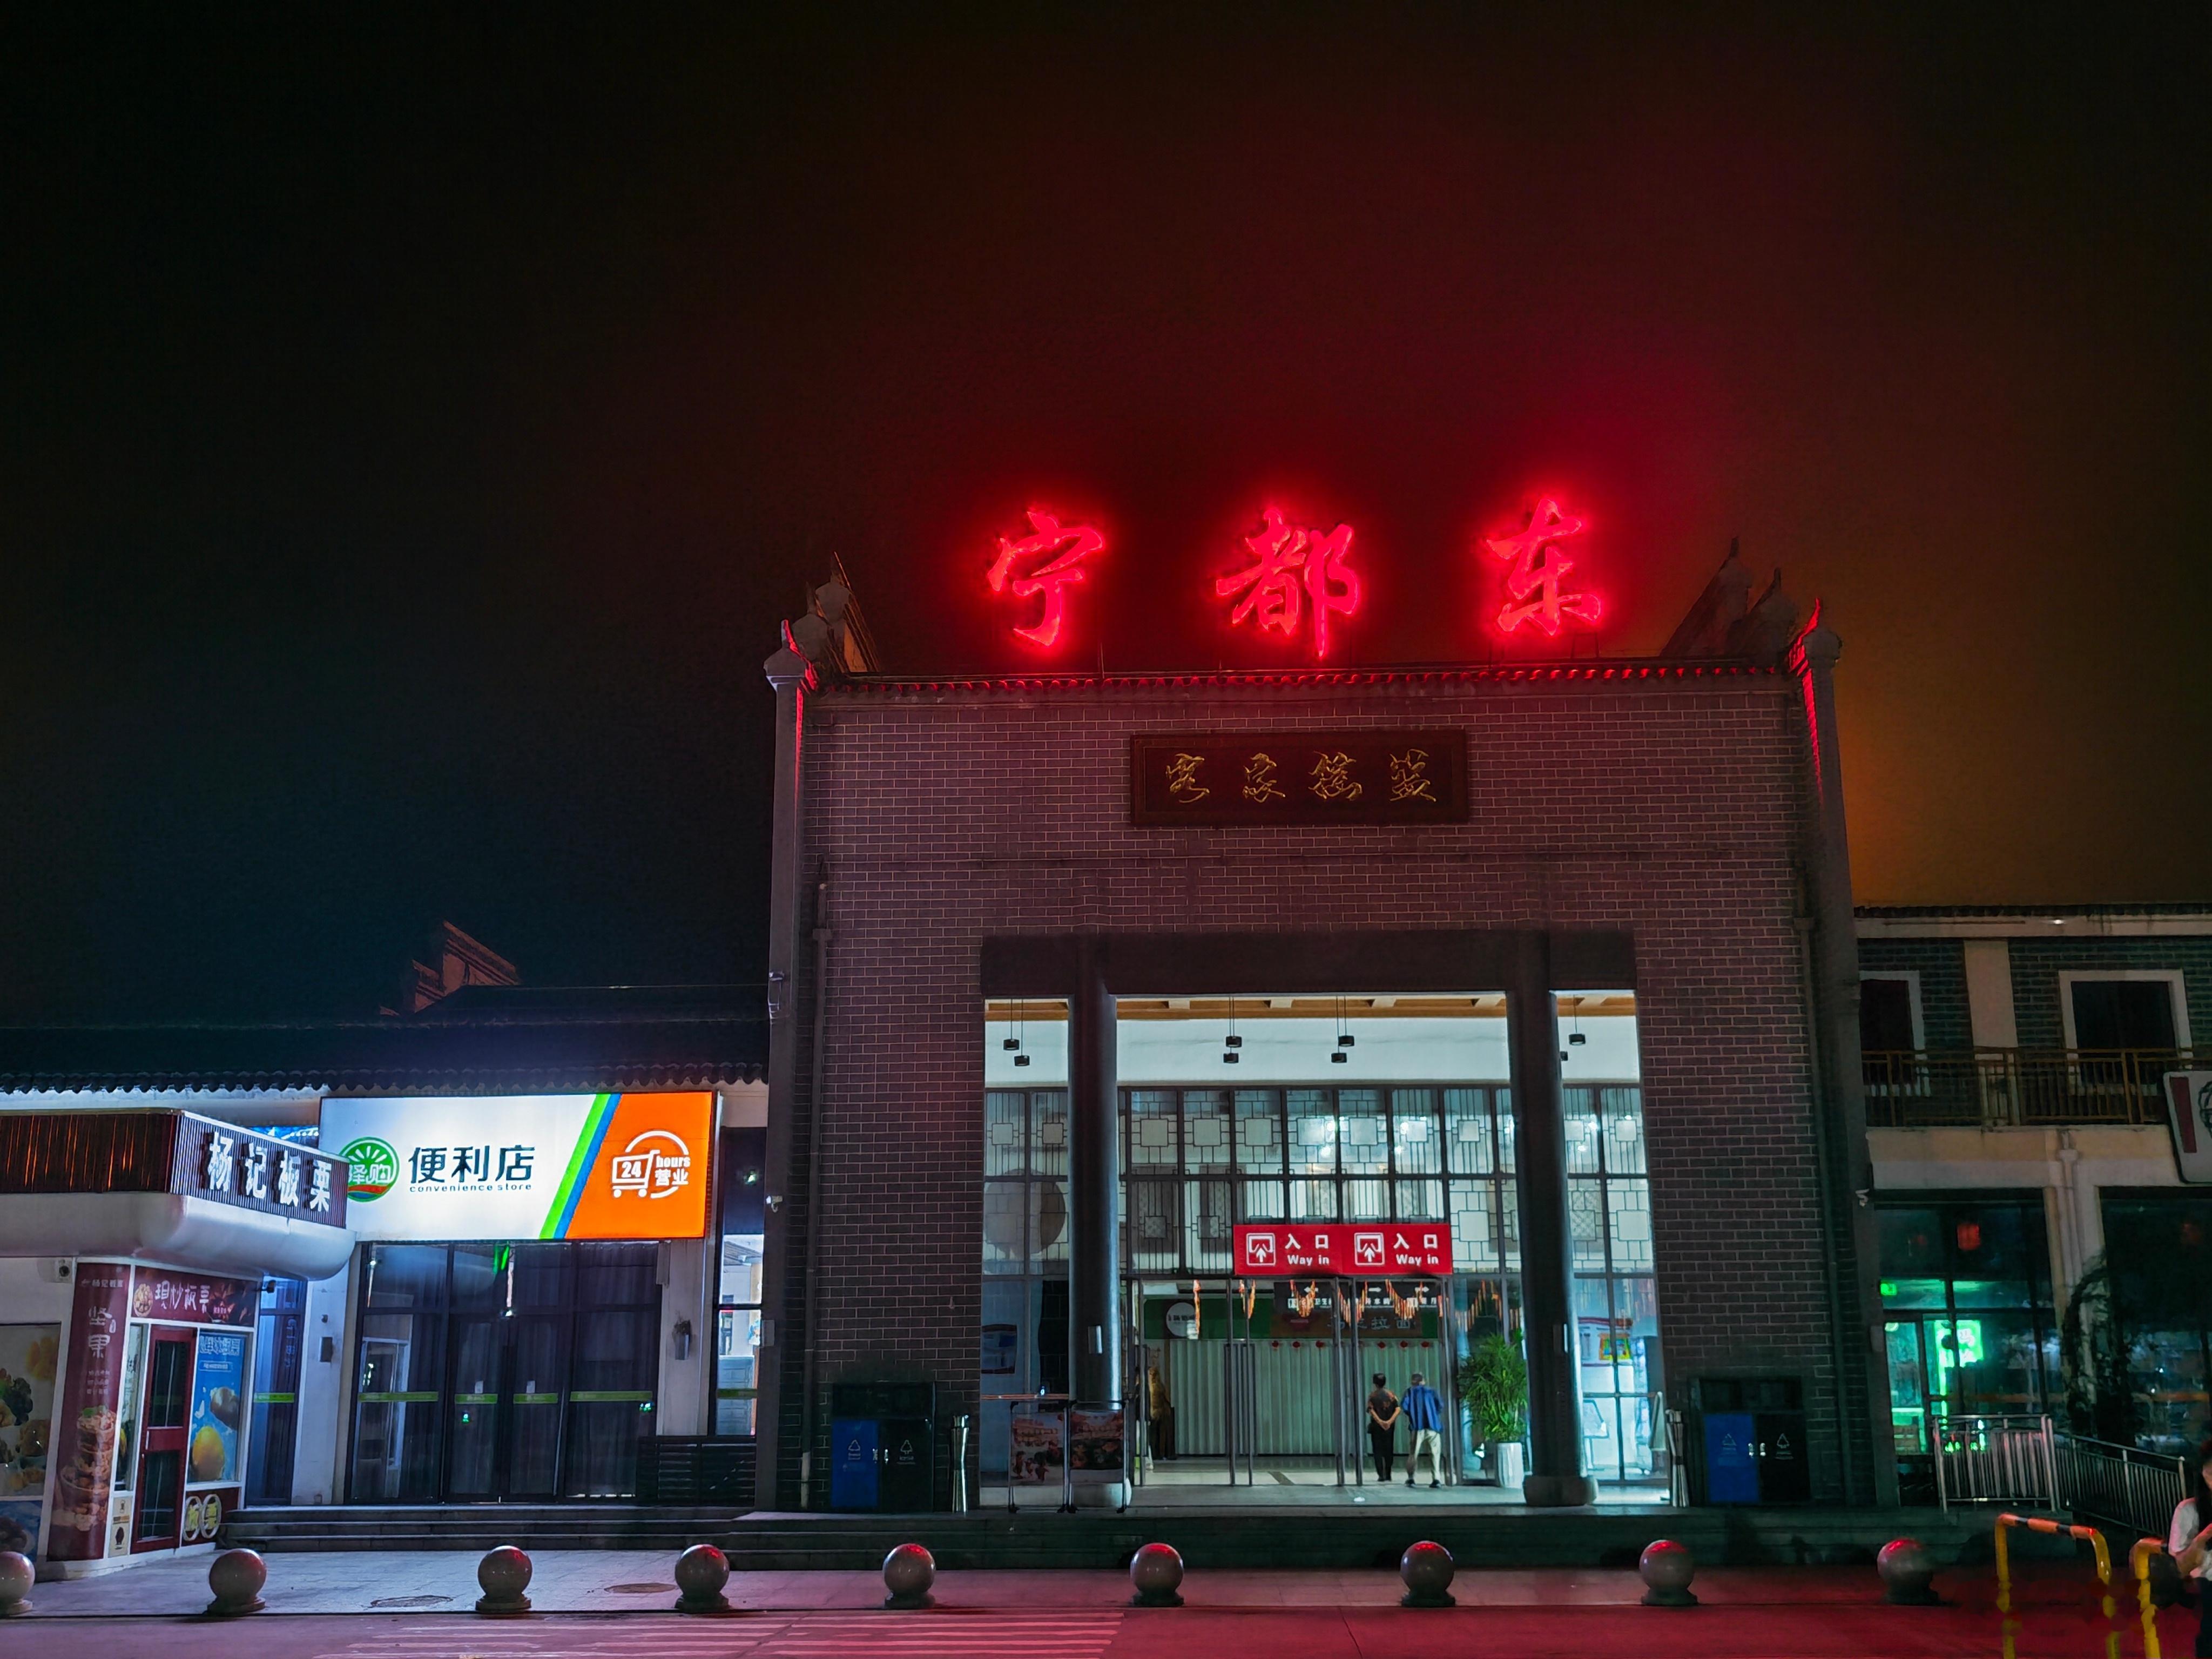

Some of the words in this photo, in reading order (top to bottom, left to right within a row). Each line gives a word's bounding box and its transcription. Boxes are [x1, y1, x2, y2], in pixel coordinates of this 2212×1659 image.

[988, 498, 1602, 657] 宁都东
[208, 1131, 332, 1212] 杨记板栗
[408, 1145, 535, 1183] 便利店
[621, 1161, 642, 1178] 24
[656, 1156, 691, 1168] hours
[655, 1168, 689, 1186] 营业
[410, 1183, 493, 1192] convenience
[497, 1183, 532, 1191] store
[1285, 1233, 1328, 1249] 入口
[1393, 1233, 1438, 1249] 入口
[1287, 1255, 1312, 1266] Way
[1318, 1255, 1330, 1264] in
[1396, 1254, 1421, 1266] Way
[1427, 1253, 1439, 1264] in
